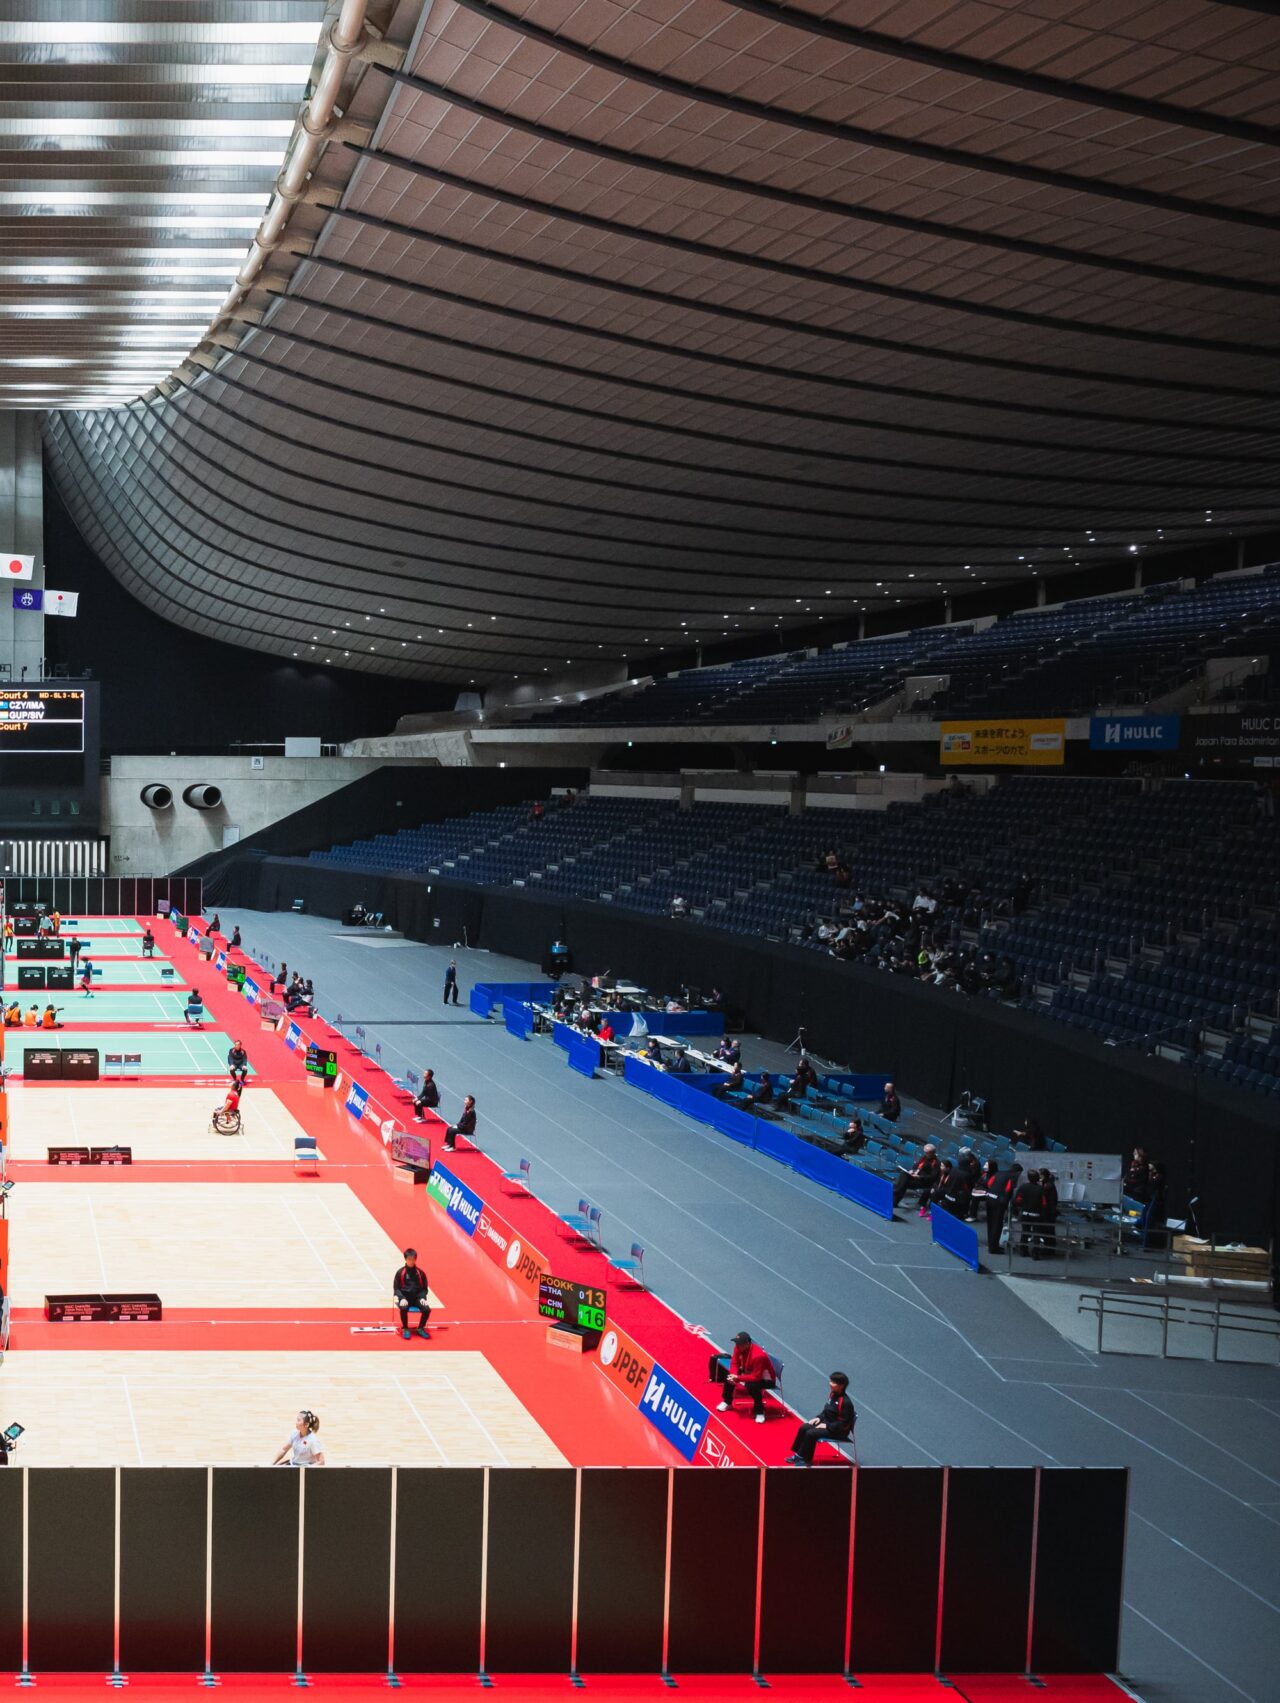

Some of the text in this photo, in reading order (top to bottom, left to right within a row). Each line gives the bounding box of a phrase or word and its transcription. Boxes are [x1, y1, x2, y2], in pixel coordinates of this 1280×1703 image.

[9, 711, 44, 720] GUP/SIV
[22, 722, 28, 730] 7
[1241, 718, 1270, 730] HULIC
[1124, 726, 1162, 738] HULIC
[328, 1052, 334, 1062] 0
[458, 1198, 480, 1225] HULIC
[516, 1253, 541, 1284] JPBF
[540, 1276, 574, 1291] POOKK
[548, 1286, 562, 1296] THA
[548, 1298, 562, 1308] CHN
[579, 1290, 605, 1308] 0 13
[540, 1304, 564, 1318] YIN M
[586, 1310, 604, 1328] 16
[612, 1347, 648, 1389] JPBF
[662, 1394, 702, 1444] HULIC
